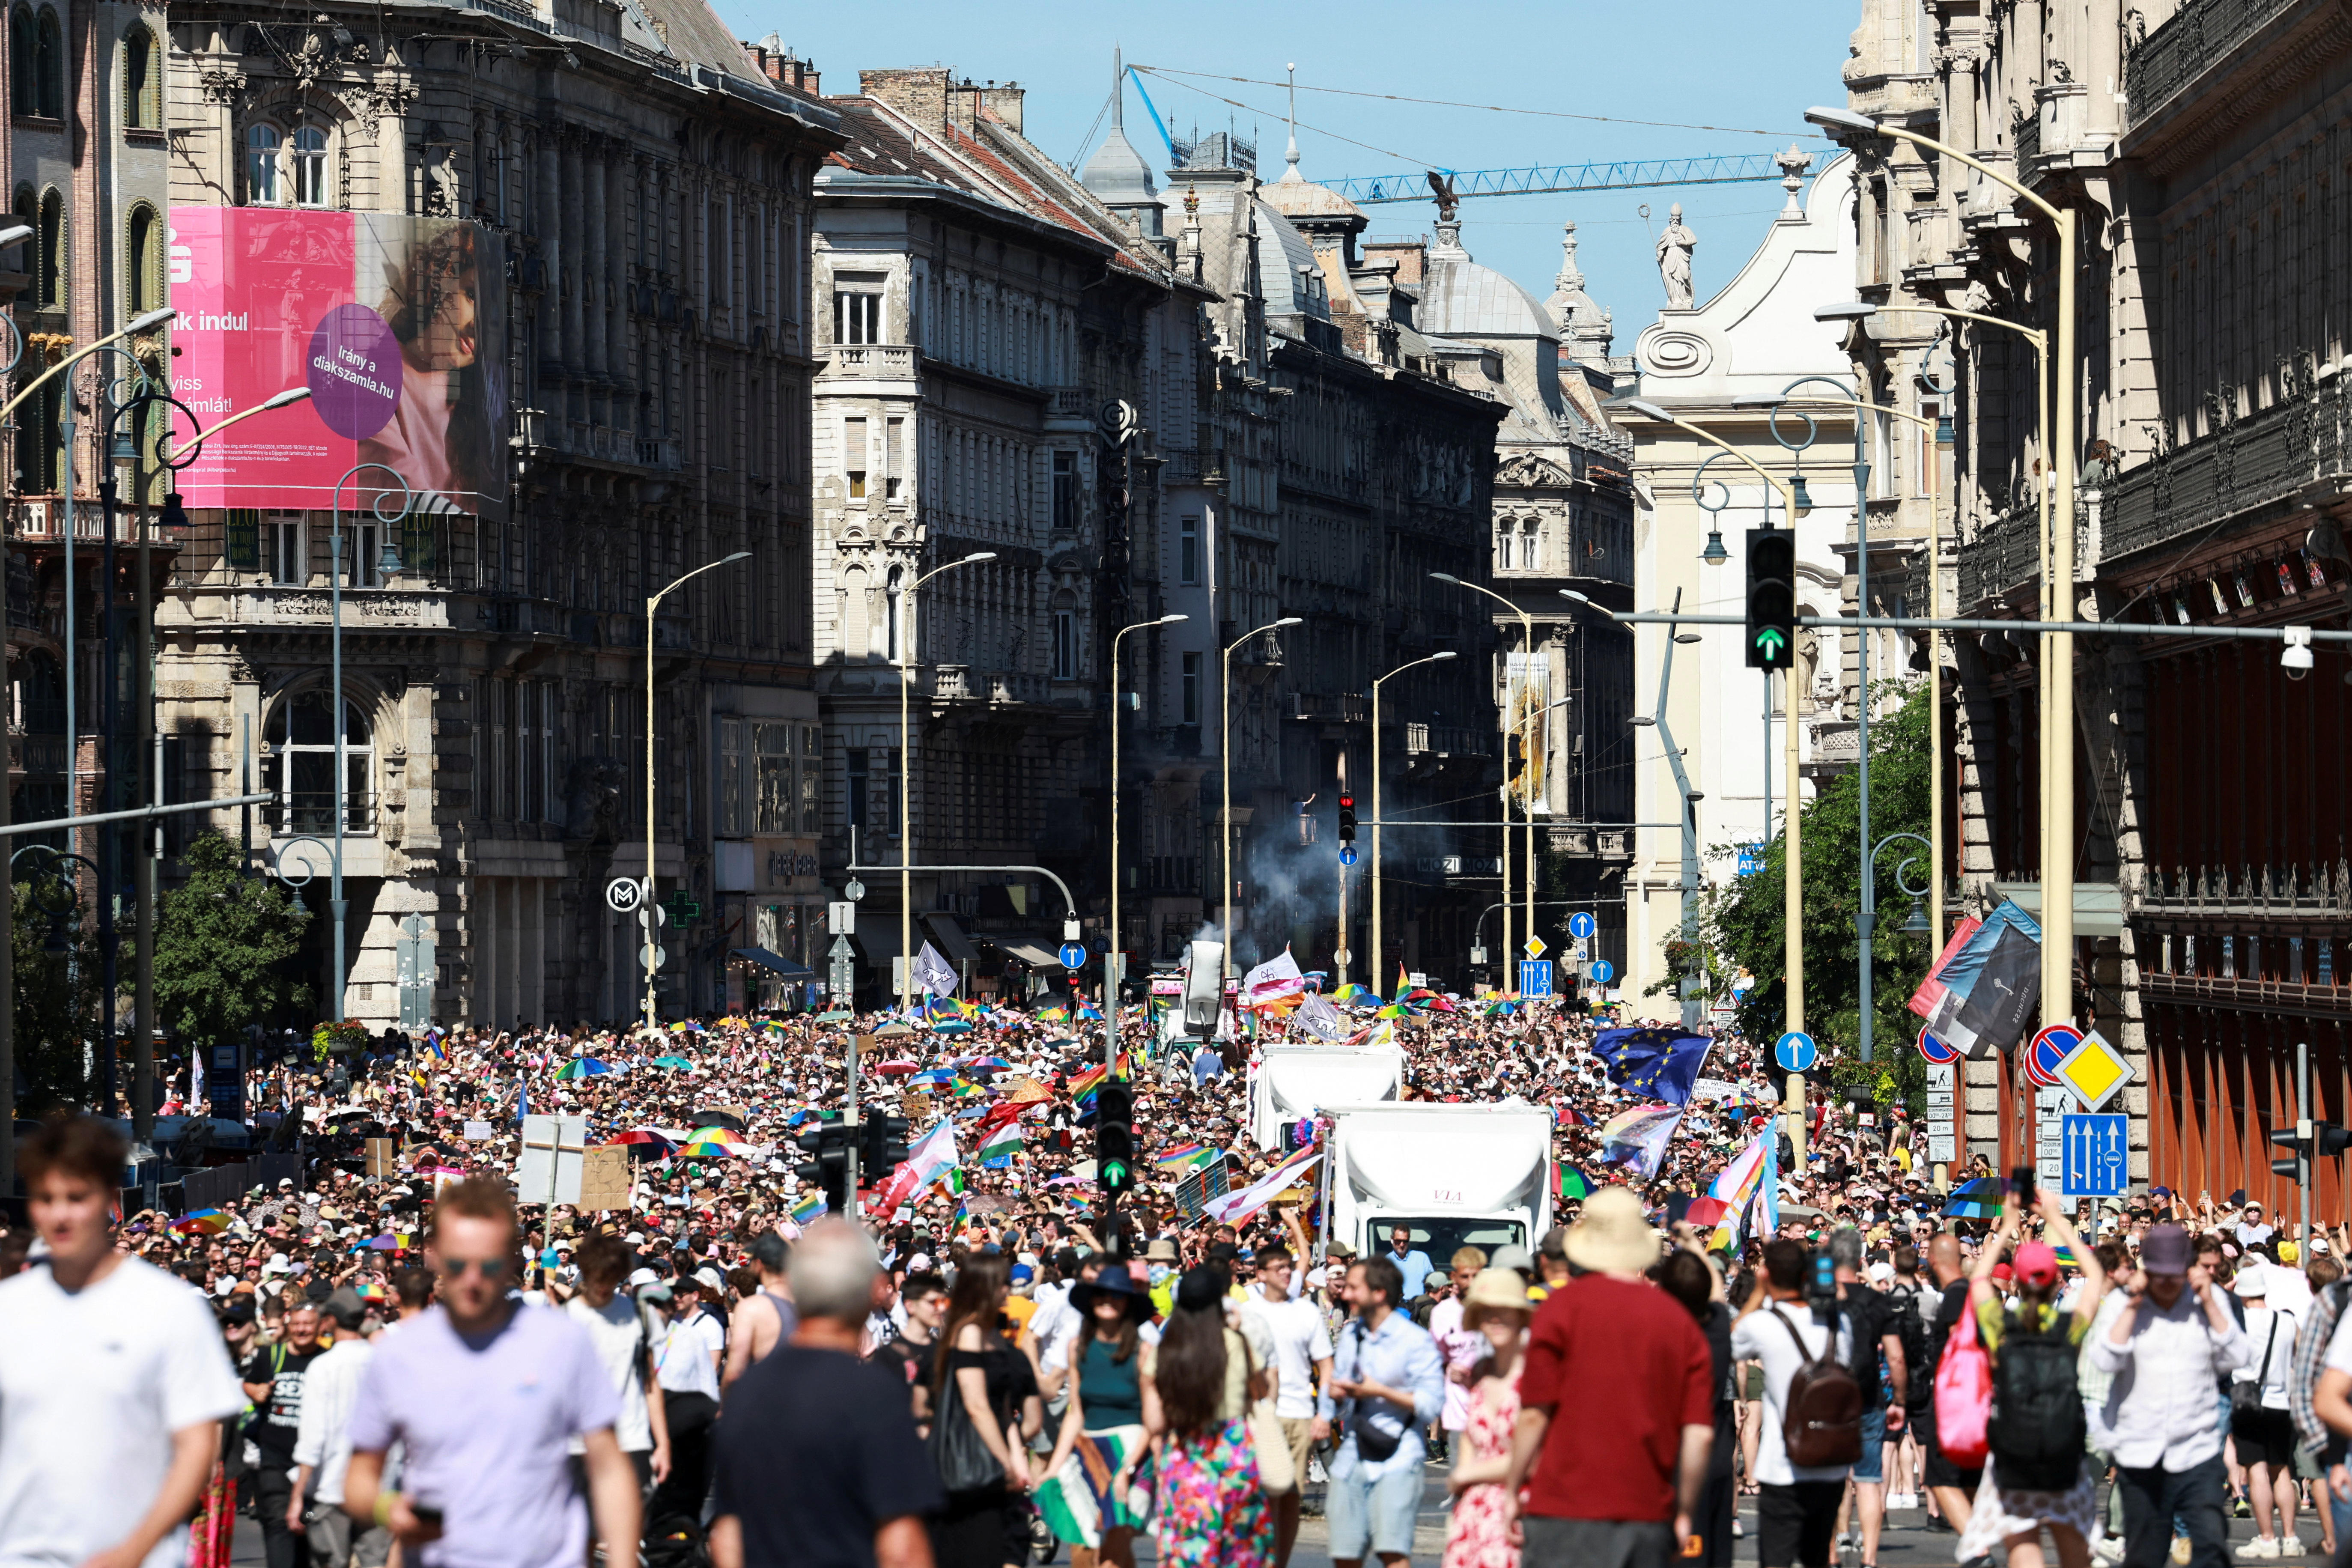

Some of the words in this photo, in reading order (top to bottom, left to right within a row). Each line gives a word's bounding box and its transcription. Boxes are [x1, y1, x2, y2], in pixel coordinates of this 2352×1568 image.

[200, 310, 247, 331] indul
[338, 345, 367, 370] Irány
[369, 362, 376, 373] a
[314, 355, 394, 399] diakszamla.hu
[172, 397, 232, 413] zámlát!
[1419, 858, 1456, 871] MOZI
[1464, 859, 1498, 871] MOZI
[1711, 1081, 1740, 1090] HATALMUK
[2049, 1164, 2059, 1172] 20
[1434, 1190, 1461, 1201] VIA
